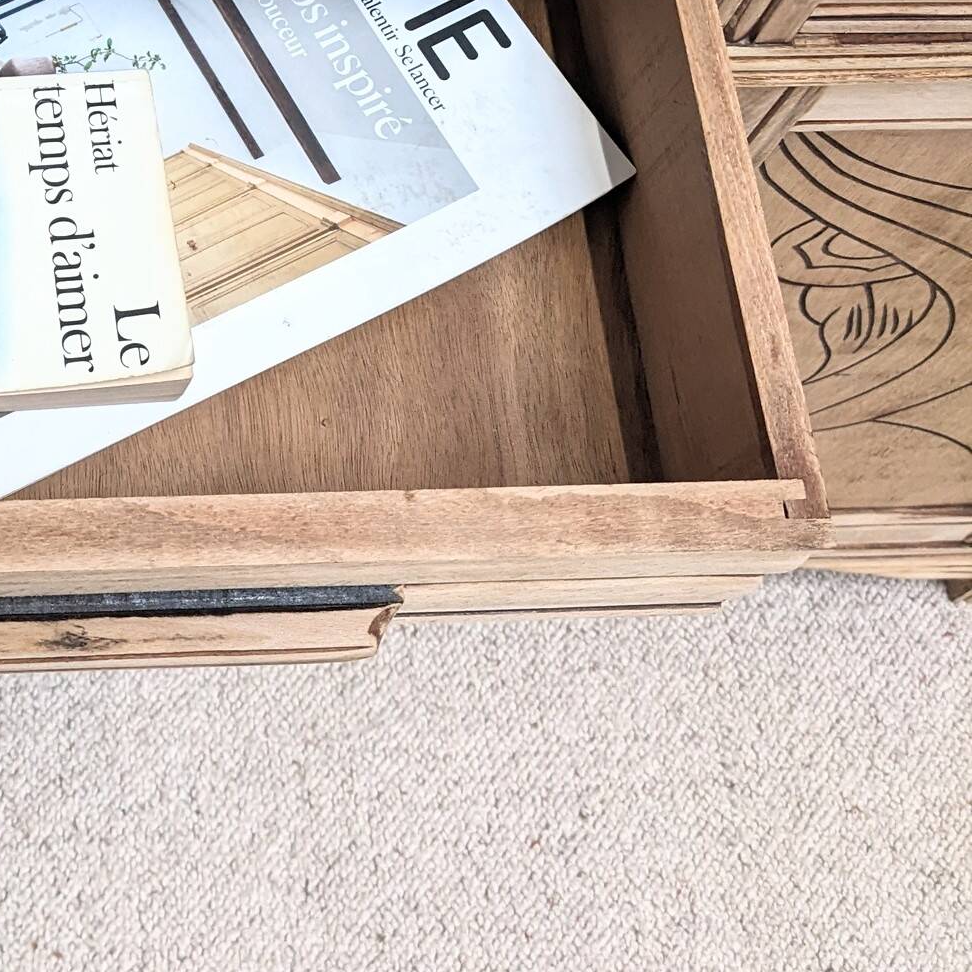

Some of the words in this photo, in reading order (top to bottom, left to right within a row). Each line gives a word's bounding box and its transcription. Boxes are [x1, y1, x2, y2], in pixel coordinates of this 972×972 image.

[84, 79, 120, 175] Hériat
[314, 19, 413, 140] inspiré
[27, 83, 74, 205] temps
[48, 216, 100, 373] d'aimer
[113, 299, 161, 369] Le
